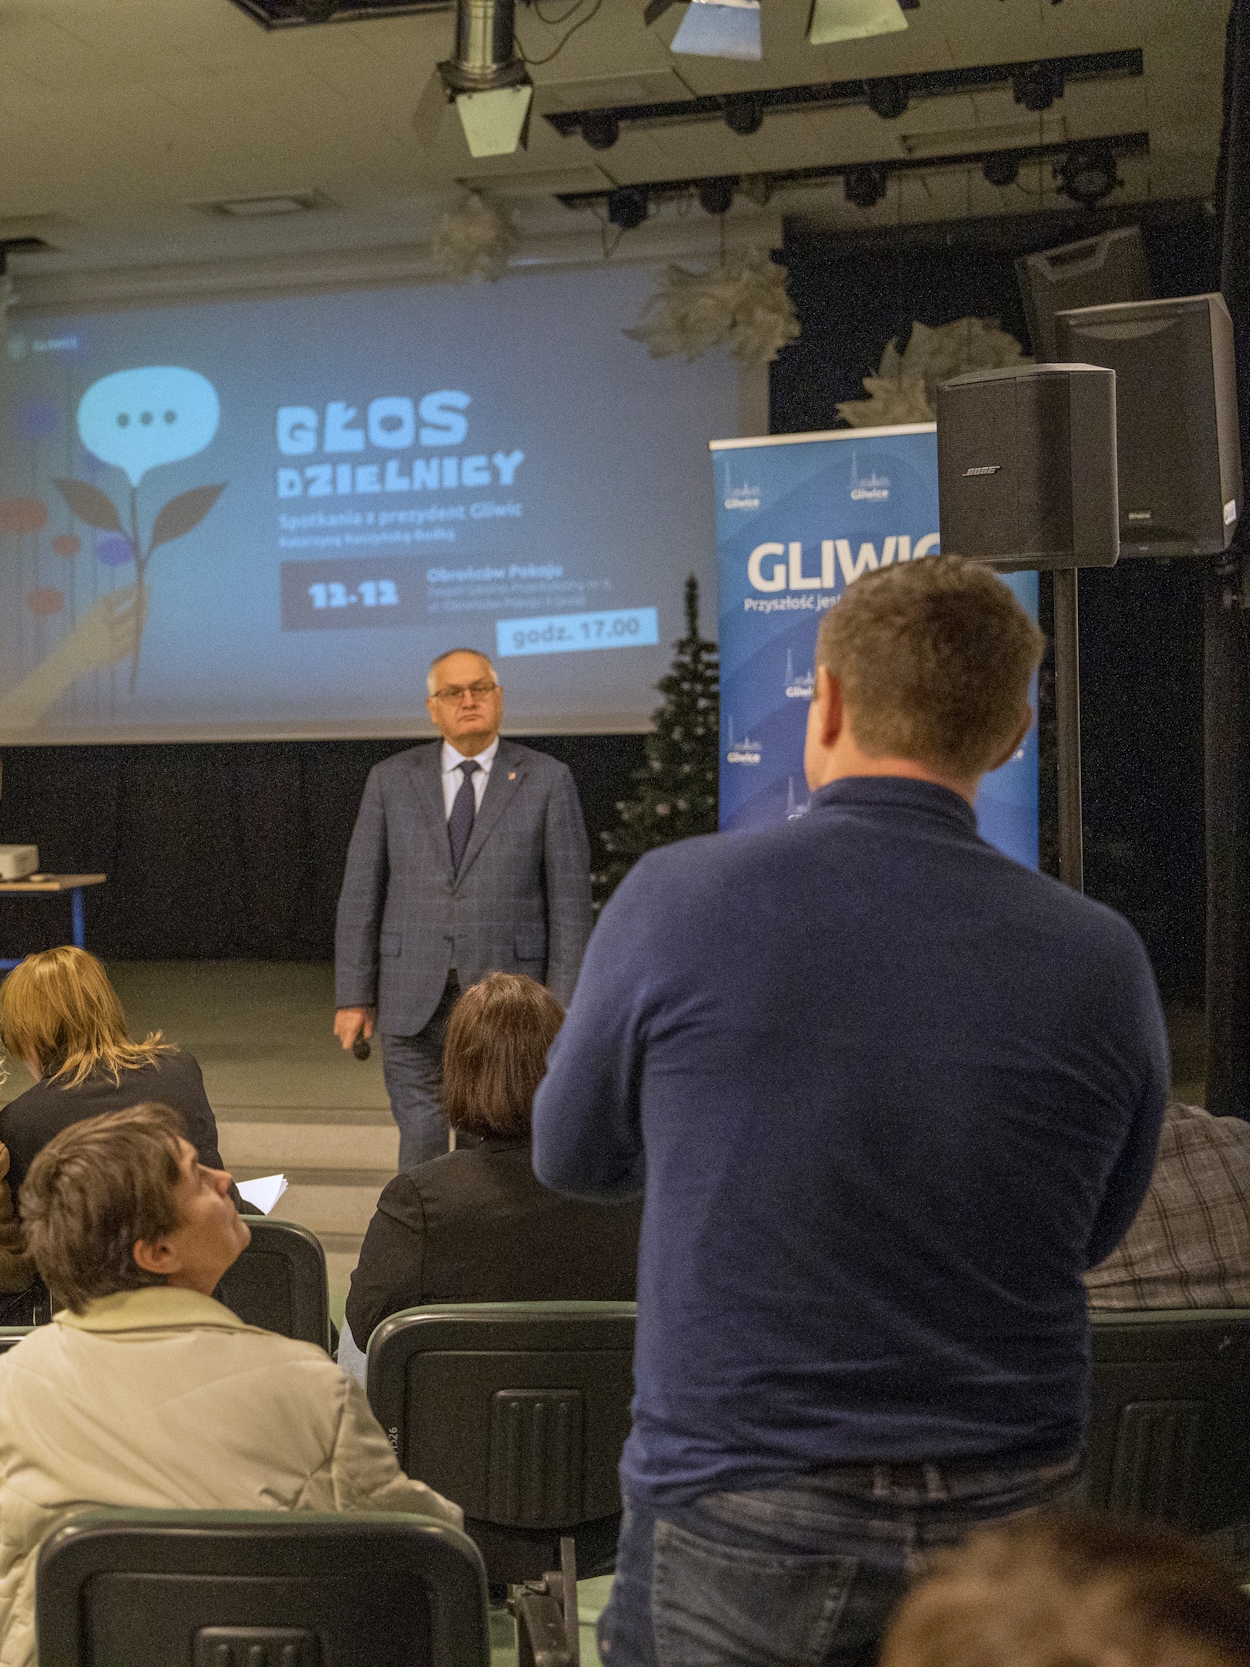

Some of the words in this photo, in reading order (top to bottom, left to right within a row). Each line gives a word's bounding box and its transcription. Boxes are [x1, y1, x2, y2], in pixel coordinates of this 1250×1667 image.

[276, 389, 473, 455] GŁOS
[277, 449, 525, 499] DZIELNICY
[962, 466, 1000, 477] BOSE
[744, 595, 814, 613] Przyszłość
[512, 623, 574, 650] godz.
[580, 616, 641, 640] 17.00
